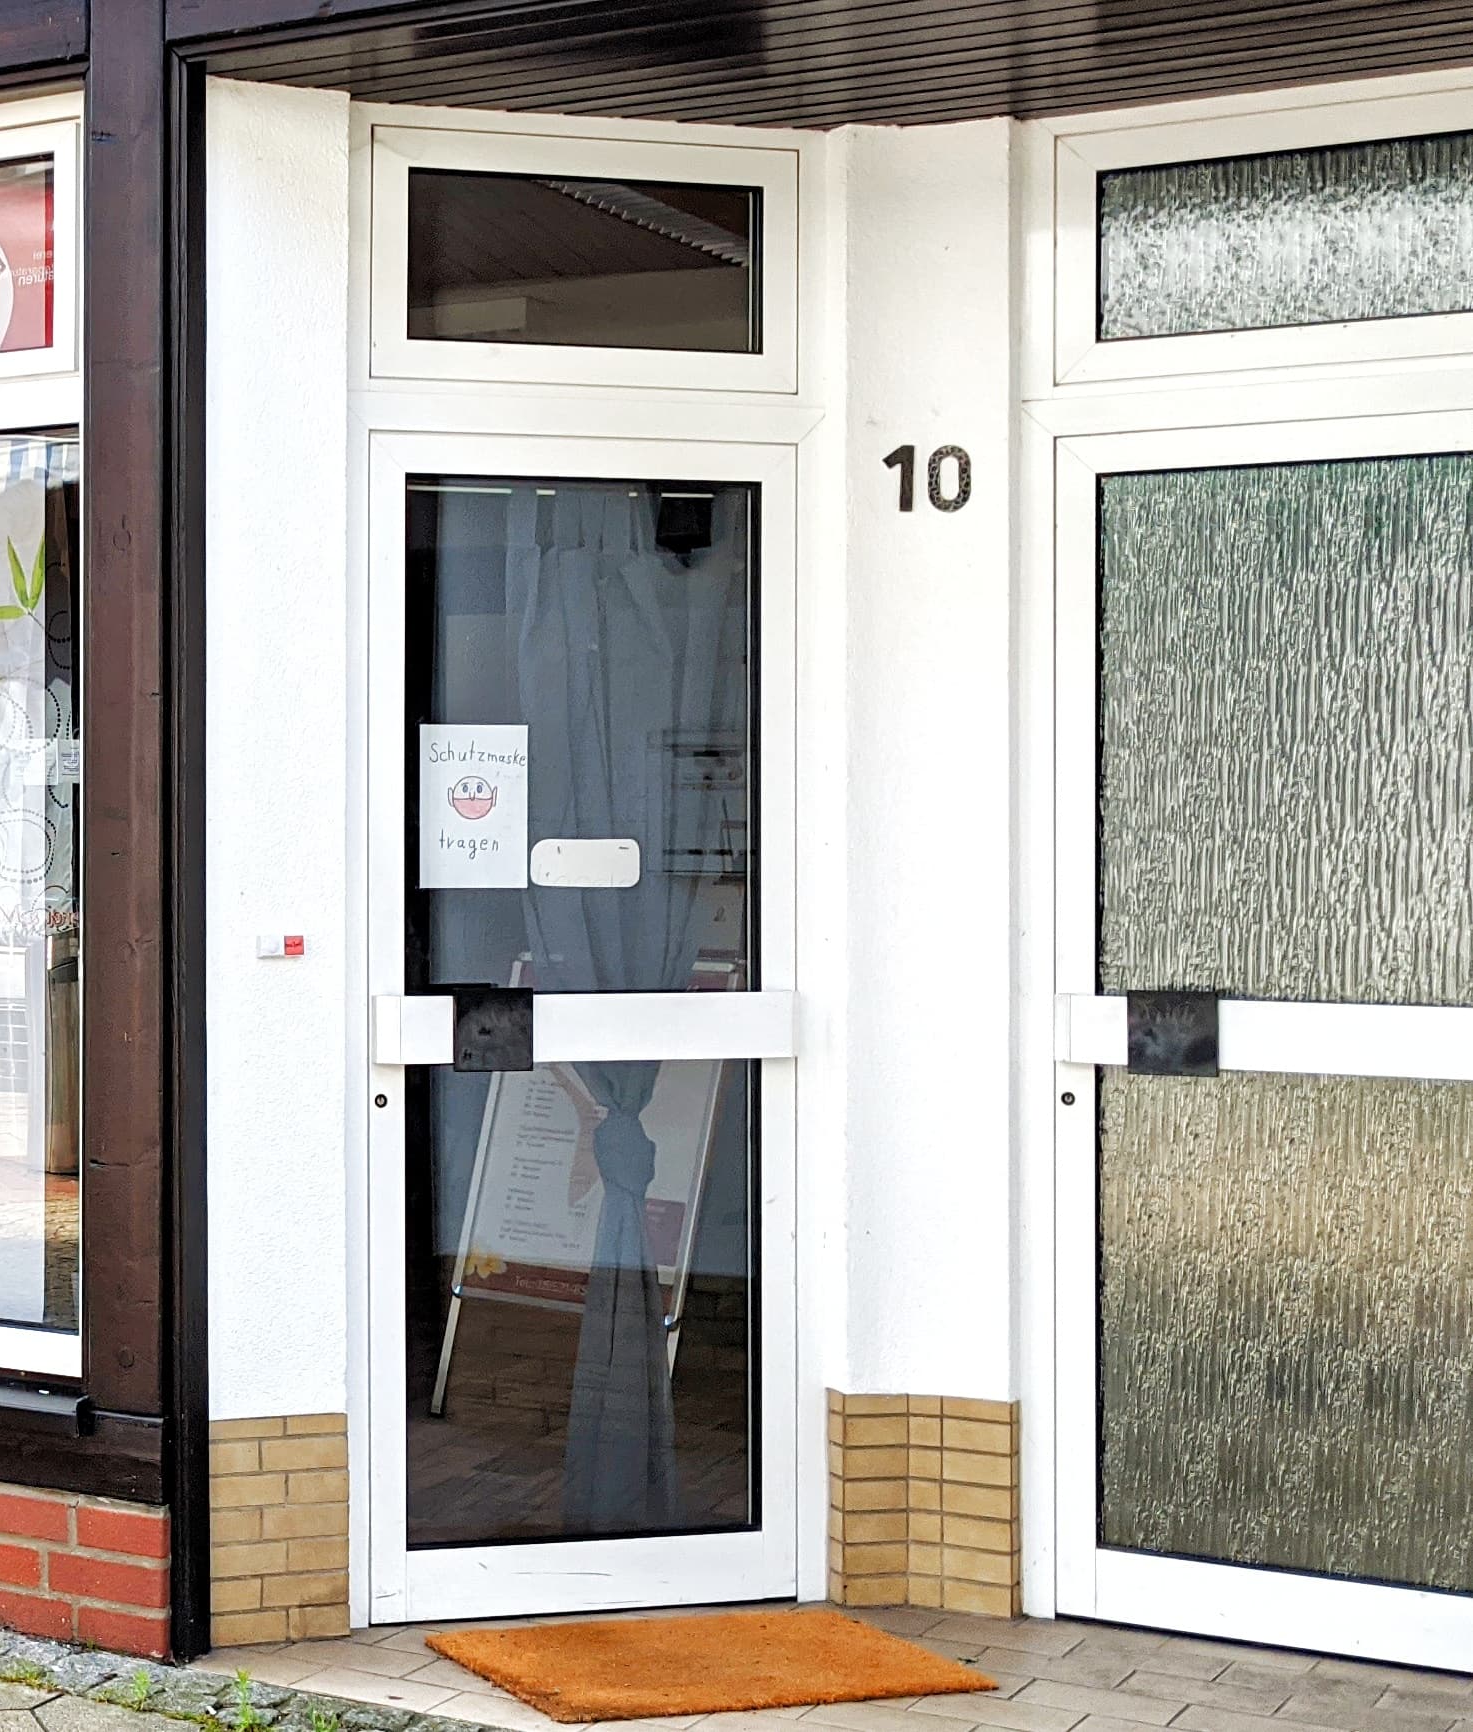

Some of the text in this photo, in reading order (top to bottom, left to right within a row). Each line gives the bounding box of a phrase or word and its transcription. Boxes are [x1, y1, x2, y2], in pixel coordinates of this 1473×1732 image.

[881, 445, 971, 513] 10
[428, 740, 527, 767] Schutzmaske
[438, 828, 500, 860] tragen
